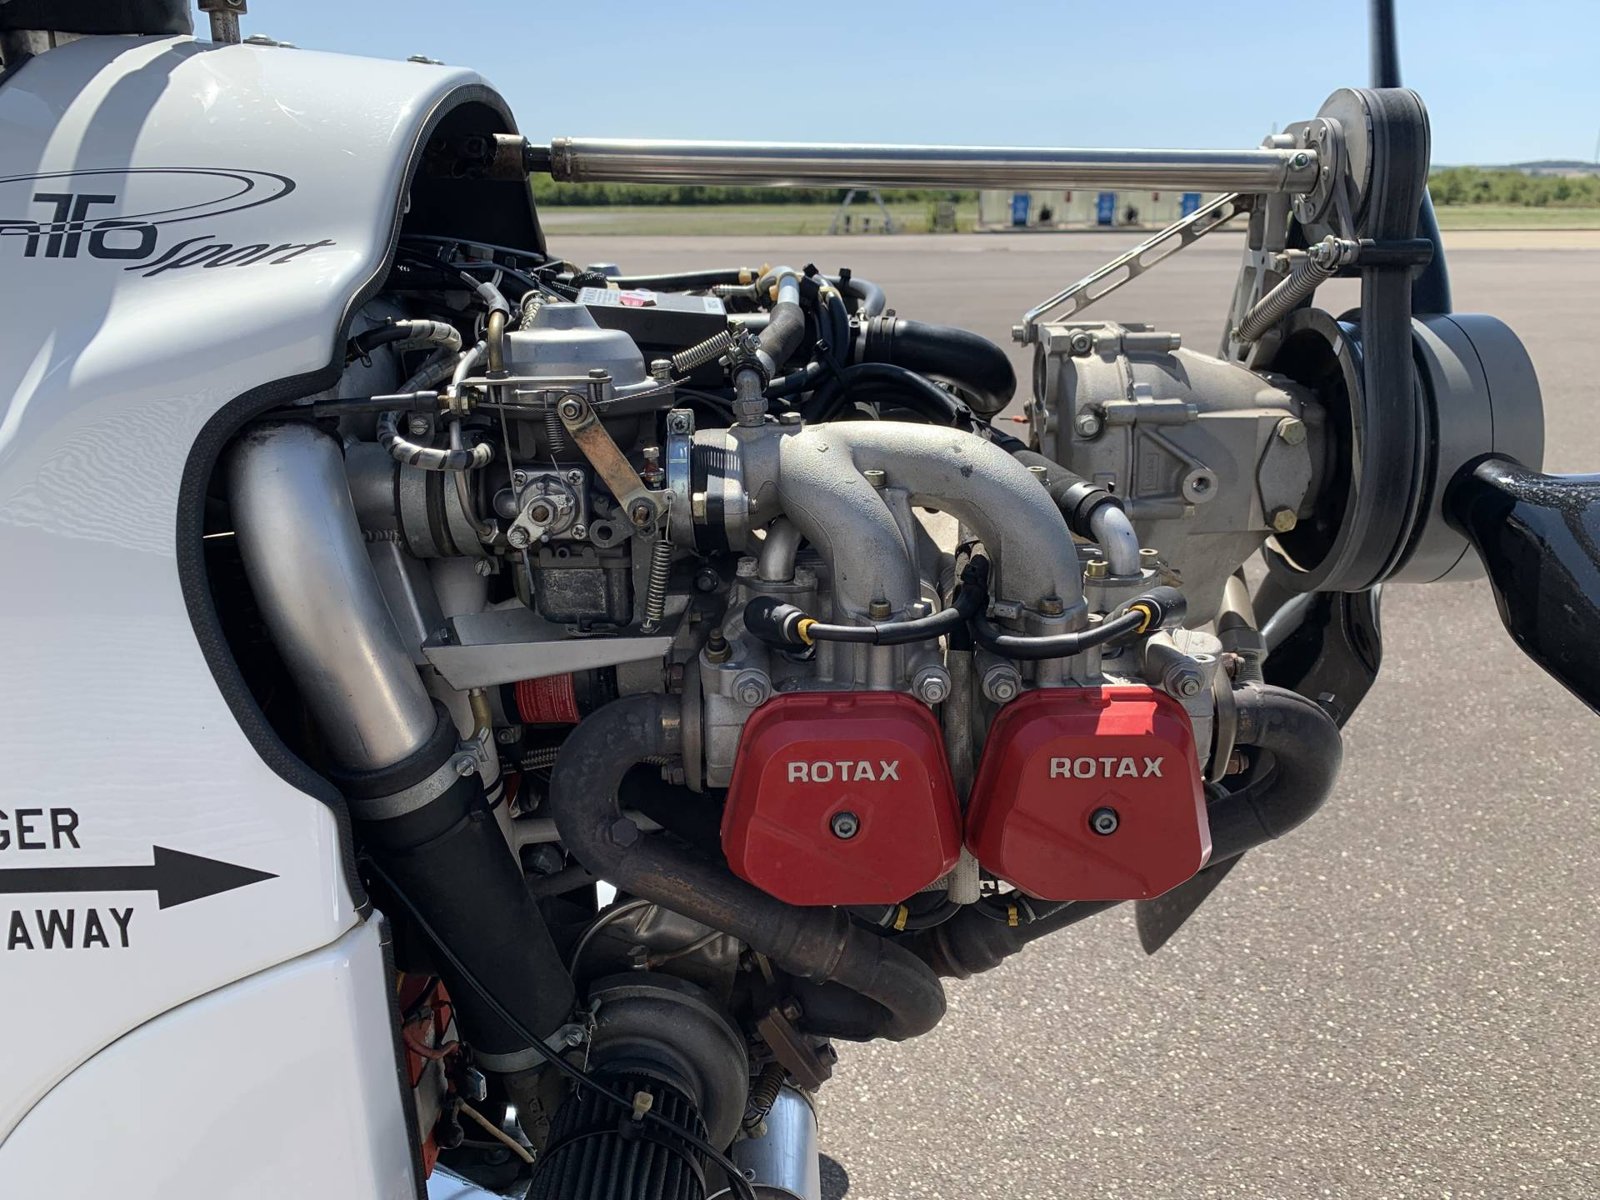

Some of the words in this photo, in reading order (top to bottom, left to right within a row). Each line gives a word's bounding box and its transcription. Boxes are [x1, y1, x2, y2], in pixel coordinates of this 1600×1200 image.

[787, 760, 900, 784] ROTAX
[1050, 756, 1164, 779] ROTAX
[7, 907, 134, 950] AWAY
